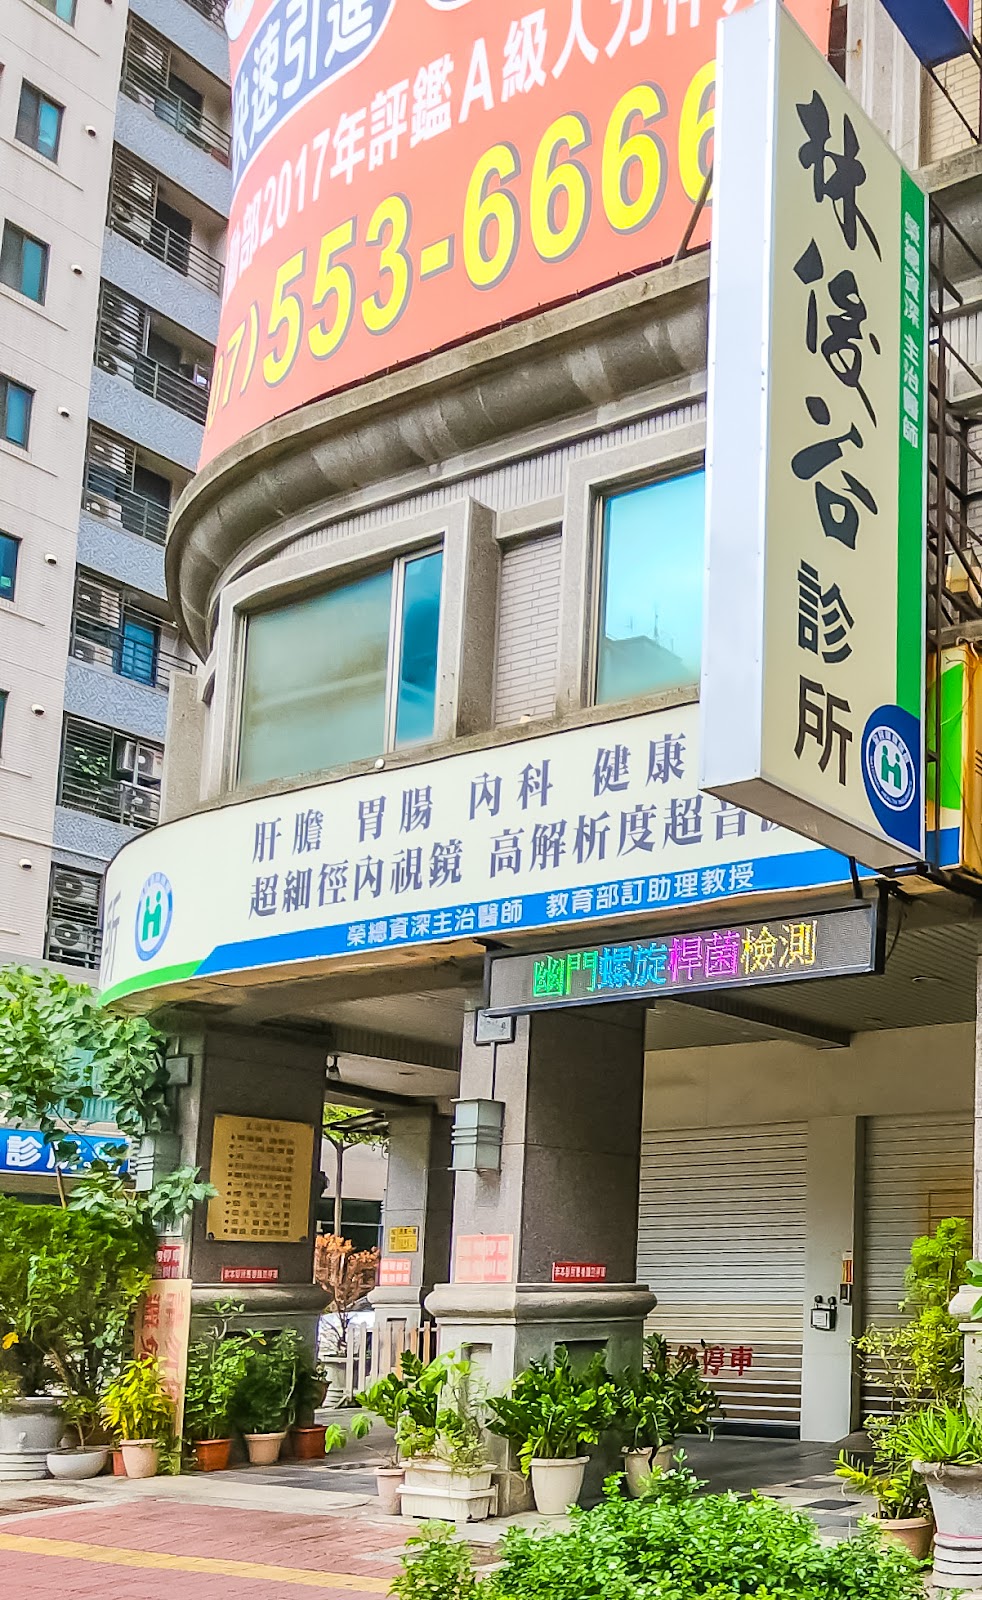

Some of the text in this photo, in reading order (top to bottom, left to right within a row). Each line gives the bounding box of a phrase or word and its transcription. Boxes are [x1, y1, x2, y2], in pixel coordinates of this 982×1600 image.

[248, 838, 463, 920] 超細徑內視鏡
[489, 794, 781, 879] 高解析度超音
[252, 732, 687, 864] 肝膽 胃腸 內科 健康
[346, 862, 755, 947] 榮總資深主治醫師 教育部訂助理教授
